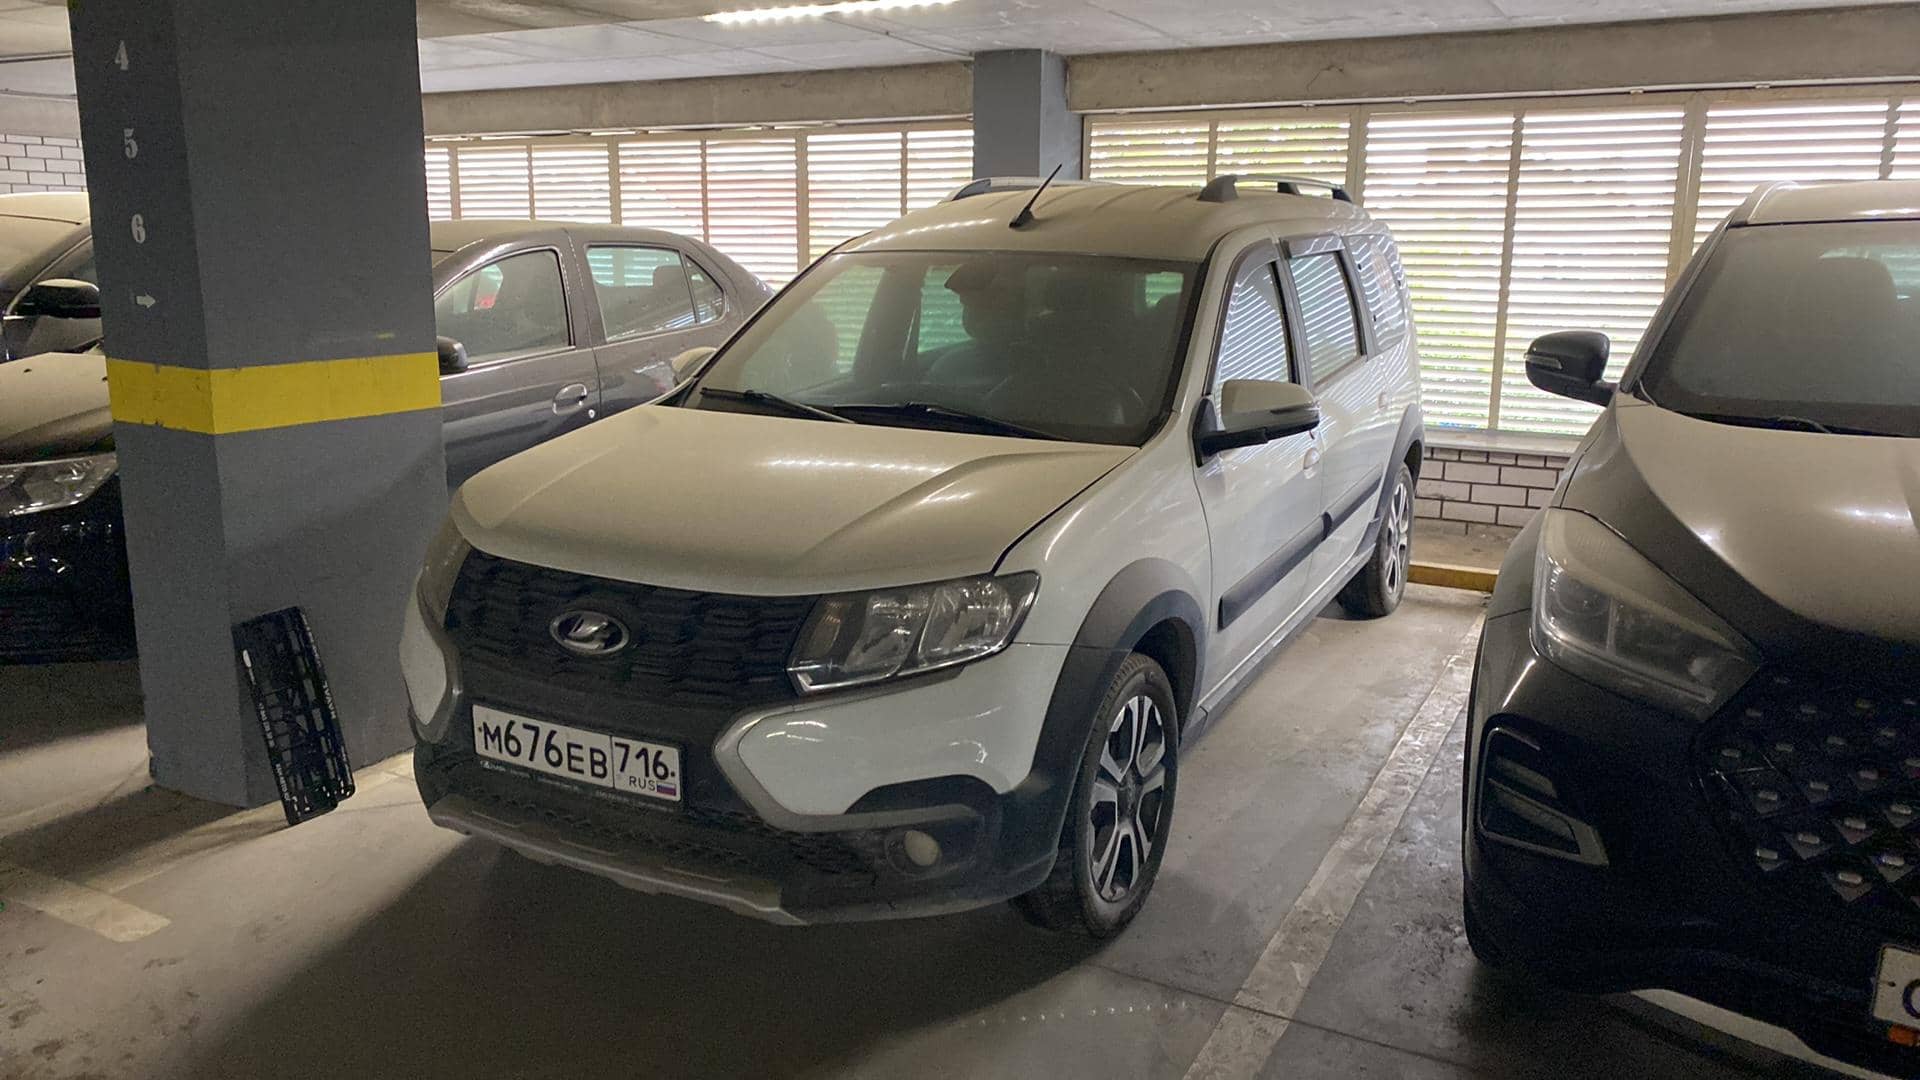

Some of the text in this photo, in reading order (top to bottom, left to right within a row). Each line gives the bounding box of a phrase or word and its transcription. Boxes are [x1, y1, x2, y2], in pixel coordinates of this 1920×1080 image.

[114, 40, 129, 71] 4
[123, 128, 138, 159] 5
[131, 214, 146, 244] 6
[614, 742, 669, 780] 716
[629, 775, 656, 791] RUS
